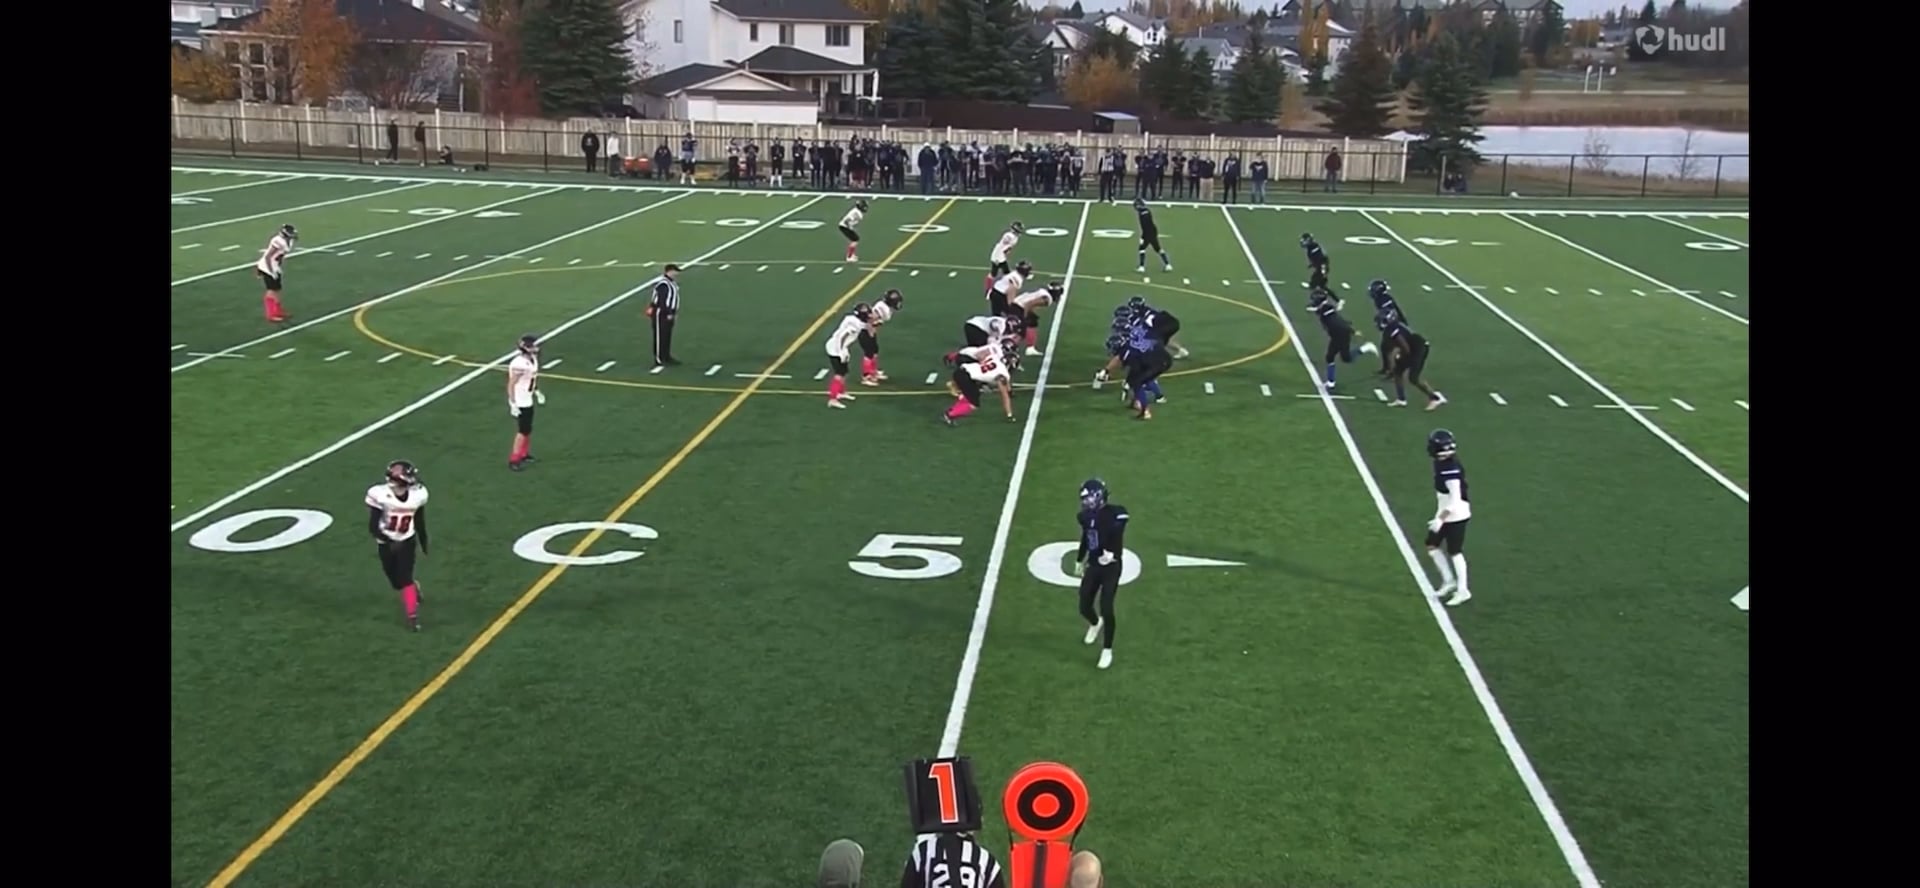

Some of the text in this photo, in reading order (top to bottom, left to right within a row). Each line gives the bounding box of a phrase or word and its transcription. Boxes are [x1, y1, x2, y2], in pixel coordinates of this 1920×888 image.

[188, 508, 334, 552] 0
[512, 521, 659, 566] C
[928, 762, 959, 823] 1
[931, 863, 977, 888] 29
